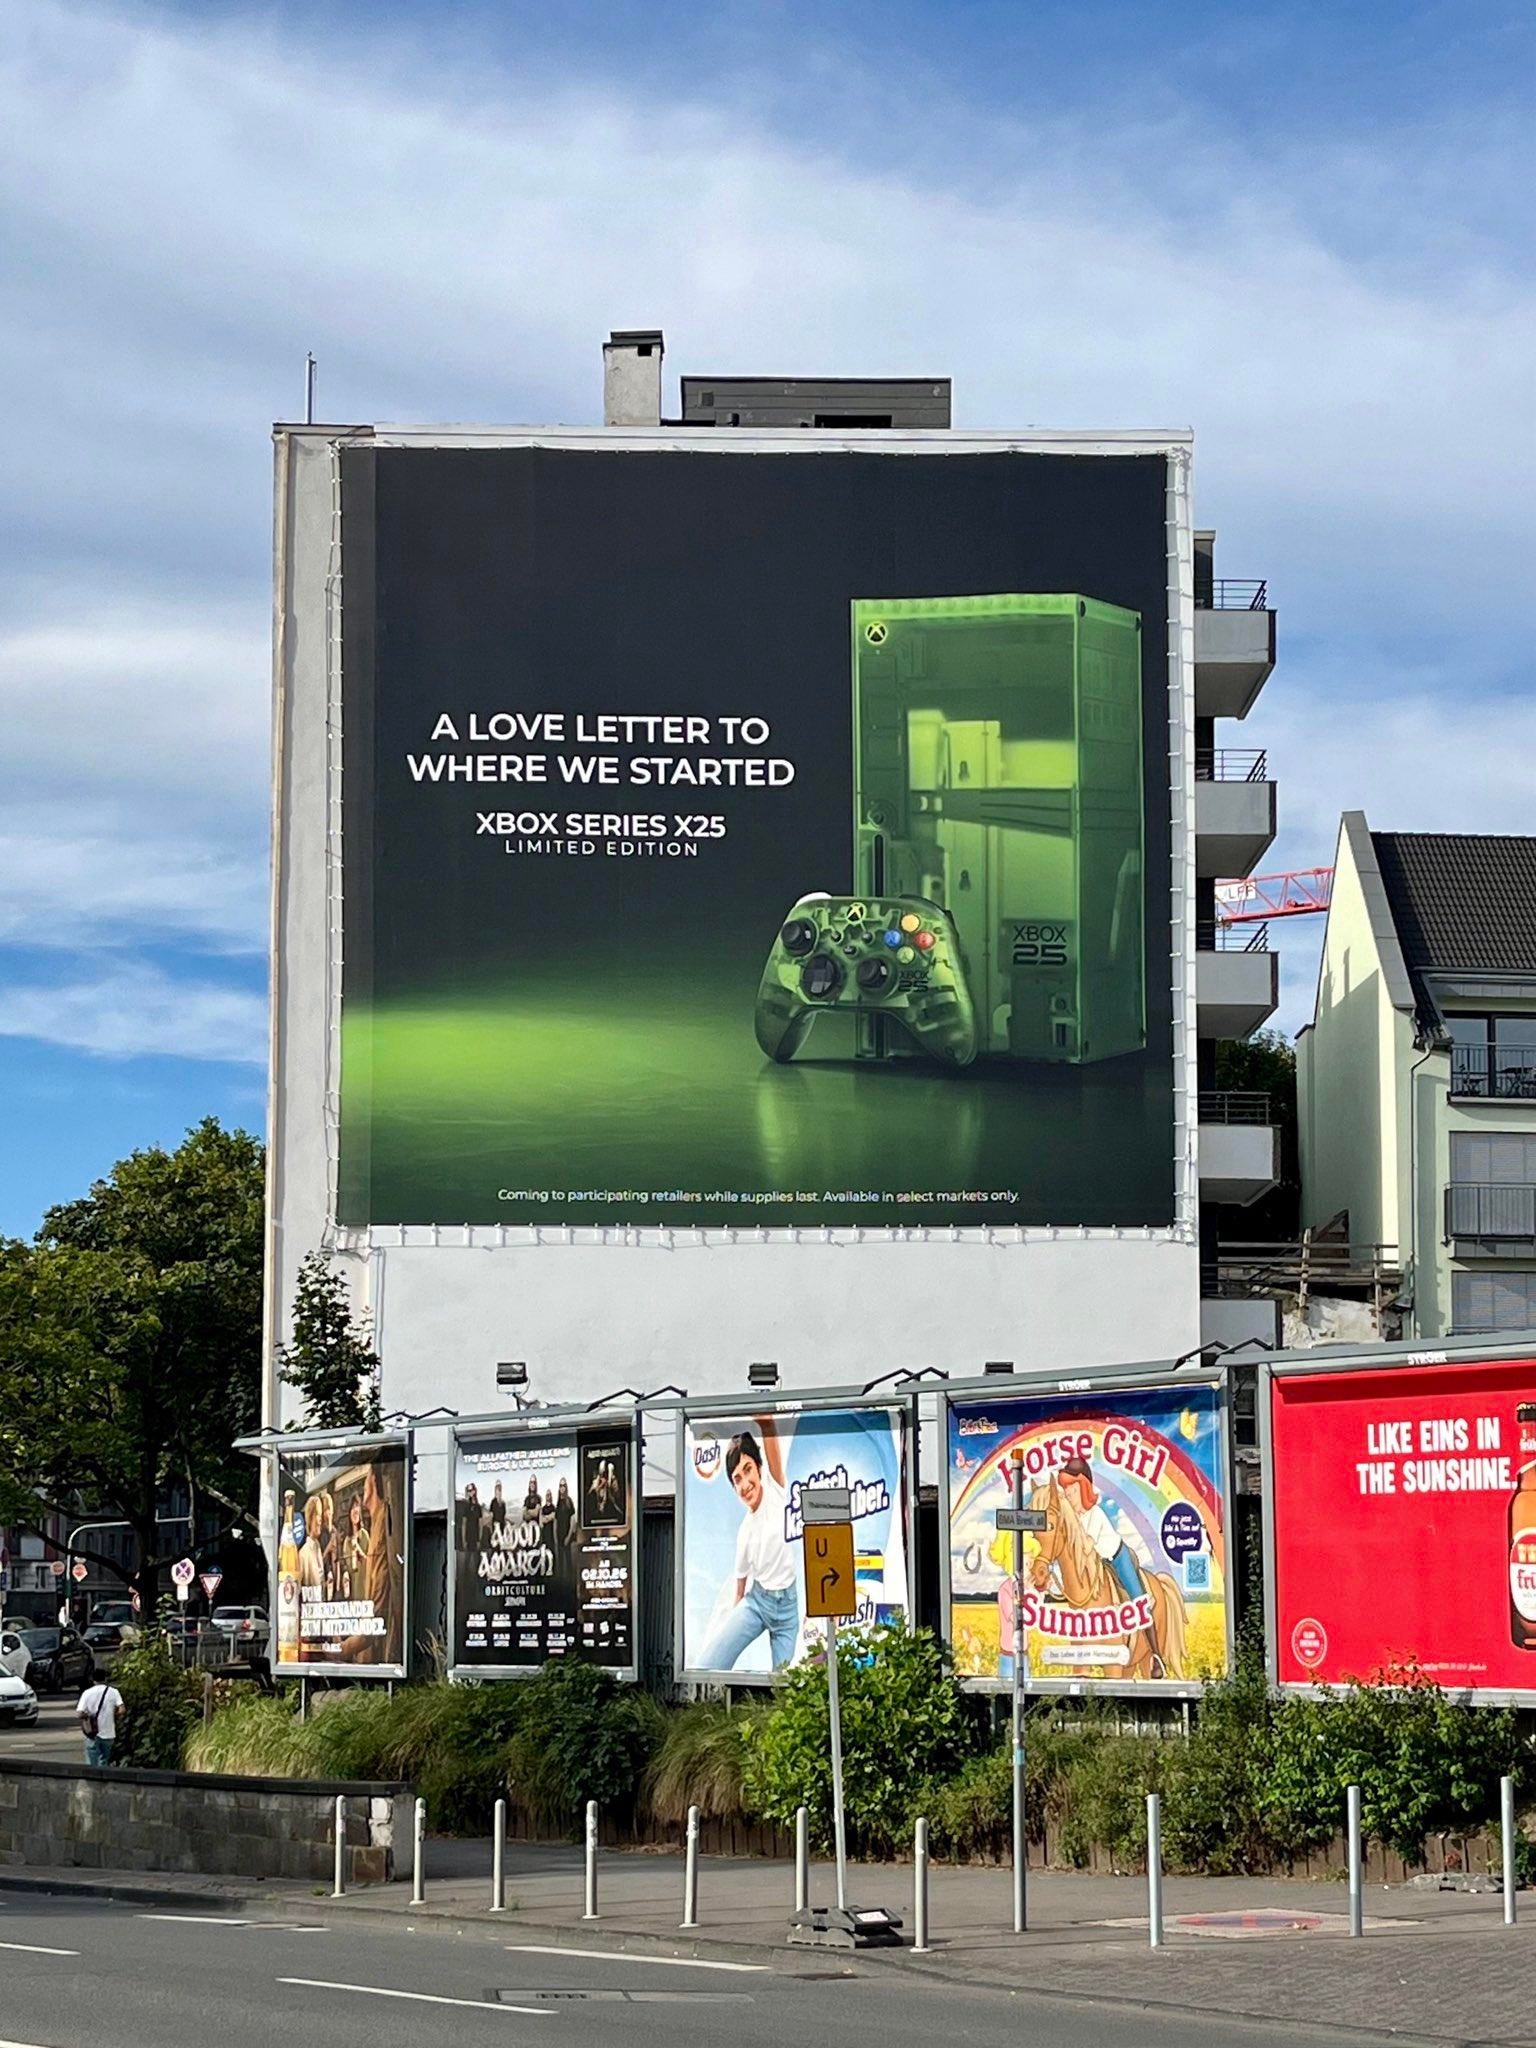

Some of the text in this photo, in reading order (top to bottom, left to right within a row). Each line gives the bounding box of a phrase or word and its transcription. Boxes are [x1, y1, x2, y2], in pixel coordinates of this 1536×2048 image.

[430, 713, 770, 745] A LOVE LETTER TO
[407, 754, 795, 786] WHERE WE STARTED
[476, 812, 726, 838] XBOX SERIES X25
[505, 840, 698, 857] LIMITED EDITION
[1012, 925, 1067, 942] XBOX
[1012, 943, 1068, 966] 25
[497, 1188, 549, 1203] Coming
[551, 1189, 566, 1201] to
[567, 1189, 649, 1204] participating
[651, 1189, 703, 1203] retailers
[703, 1189, 739, 1203] while
[740, 1189, 794, 1205] supplies
[822, 1190, 880, 1203] Available
[881, 1190, 895, 1203] in
[896, 1190, 934, 1203] select
[936, 1189, 989, 1203] markets
[990, 1189, 1020, 1205] only.
[1367, 1421, 1412, 1455] LIKE
[1419, 1418, 1469, 1452] EINS
[1476, 1416, 1501, 1450] IN
[695, 1440, 720, 1466] Dash
[1103, 1428, 1170, 1487] Girl
[1356, 1456, 1518, 1495] THE SUNSHINE.
[815, 1538, 829, 1558] U
[1022, 1592, 1151, 1638] Summer
